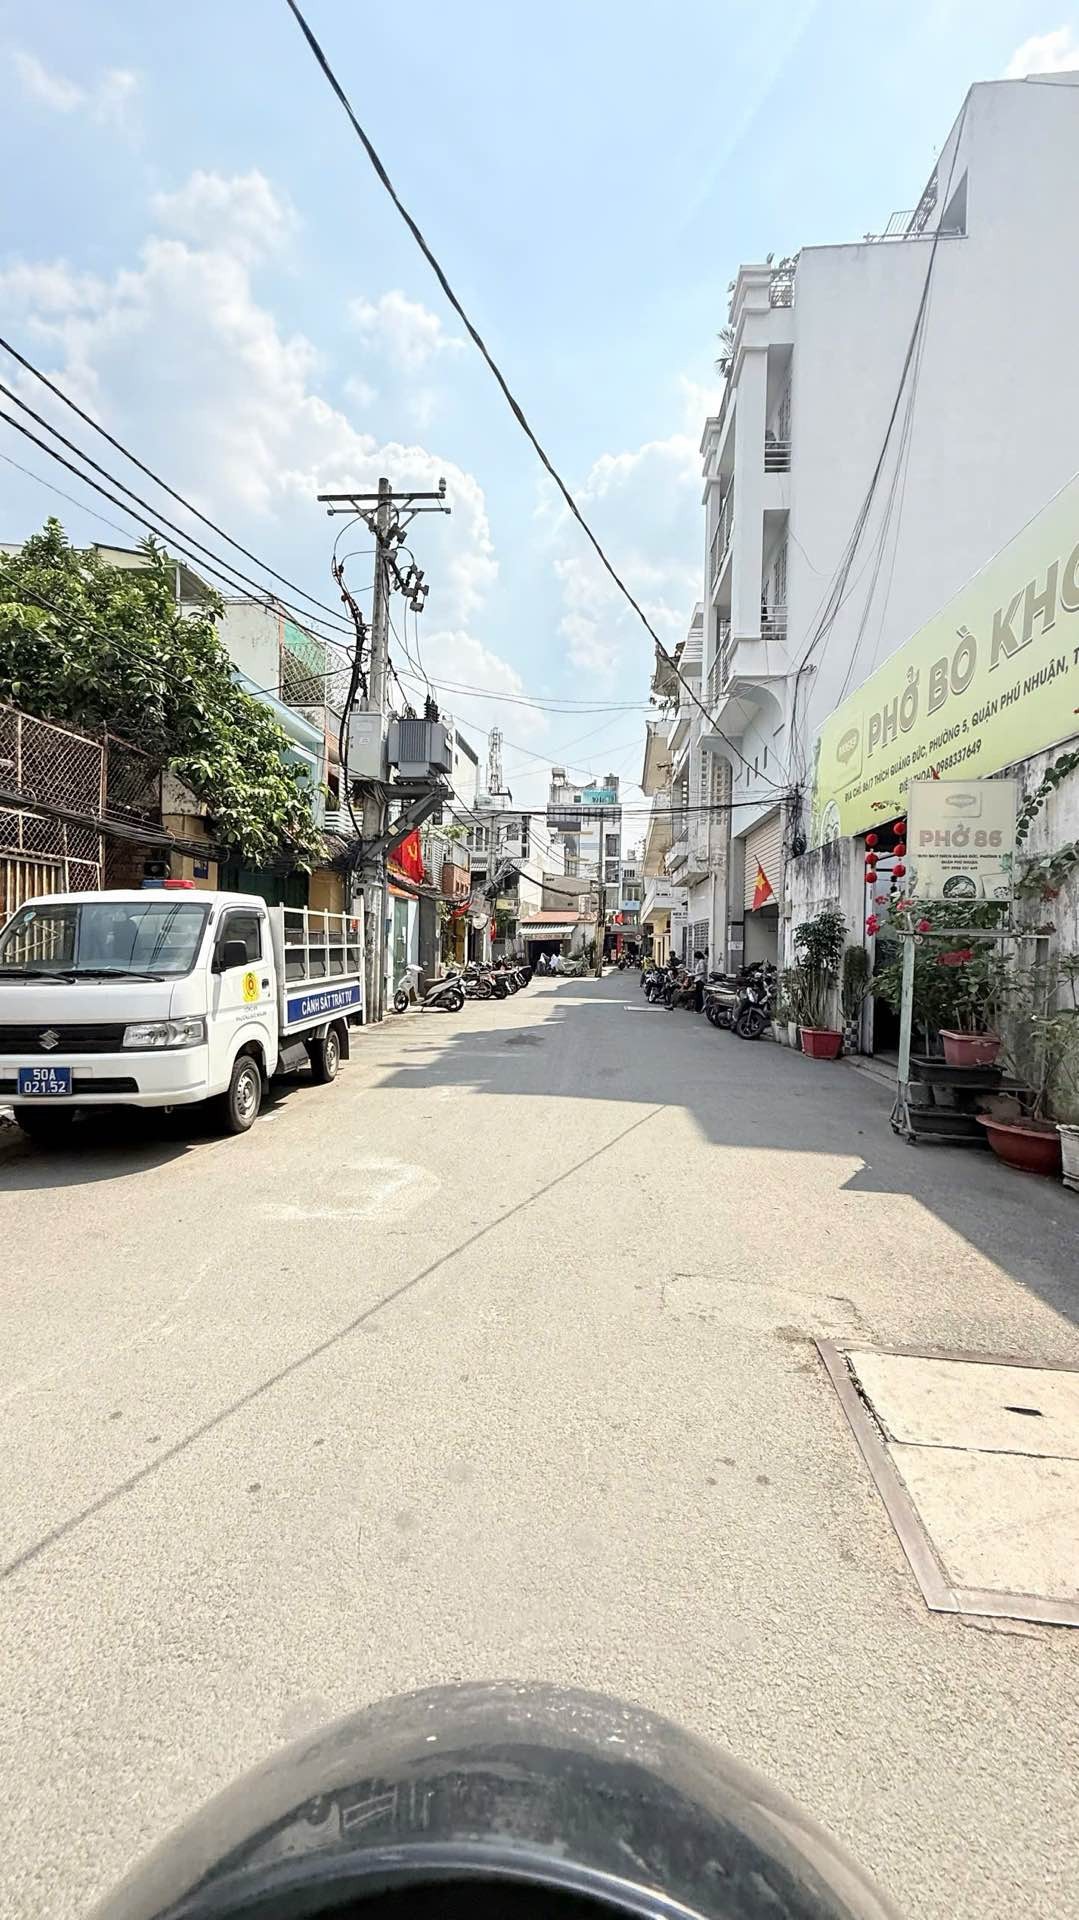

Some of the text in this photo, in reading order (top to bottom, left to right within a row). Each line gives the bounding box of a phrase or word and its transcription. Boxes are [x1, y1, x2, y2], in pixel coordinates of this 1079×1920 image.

[867, 665, 920, 757] PHỞ
[927, 625, 977, 716] BÒ
[929, 725, 960, 753] PHƯỜNG
[962, 719, 969, 733] 5,
[971, 700, 998, 727] QUẬN
[1000, 681, 1021, 709] PHÚ
[1023, 656, 1069, 696] NHUẬN,
[919, 822, 1003, 848] PHỞ 86
[301, 990, 352, 1015] CẢNH SÁT TRẬT TỰ
[33, 1068, 56, 1080] 50A
[24, 1081, 66, 1093] 021.52
